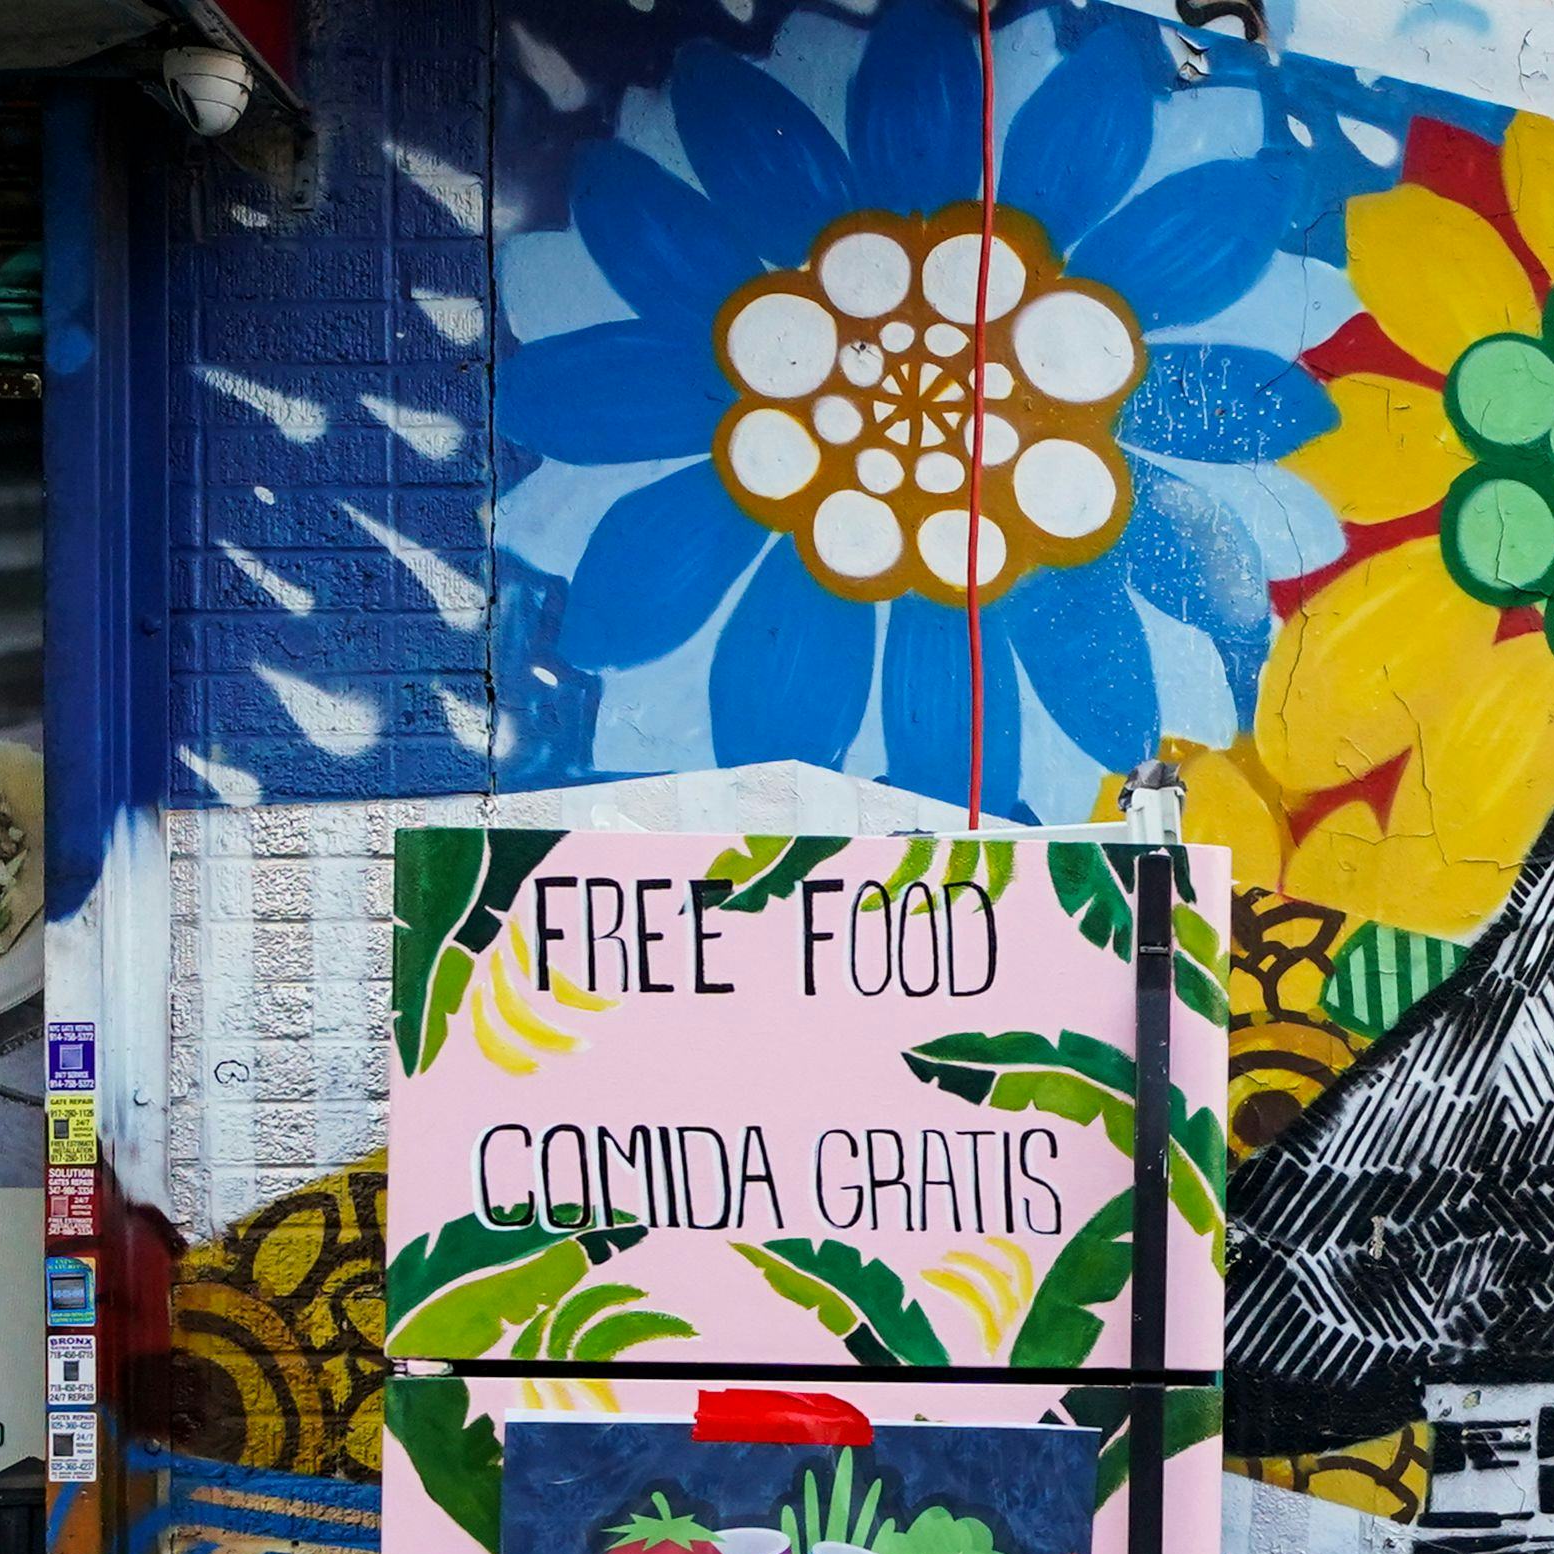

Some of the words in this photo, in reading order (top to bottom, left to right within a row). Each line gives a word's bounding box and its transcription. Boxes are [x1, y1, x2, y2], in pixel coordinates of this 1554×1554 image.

[531, 876, 736, 995] FREE
[799, 878, 998, 998] FOOD
[48, 1168, 95, 1178] SOLUTION
[475, 1123, 785, 1231] COMIDA
[814, 1127, 1063, 1236] GRATIS
[50, 1337, 92, 1345] BRONX
